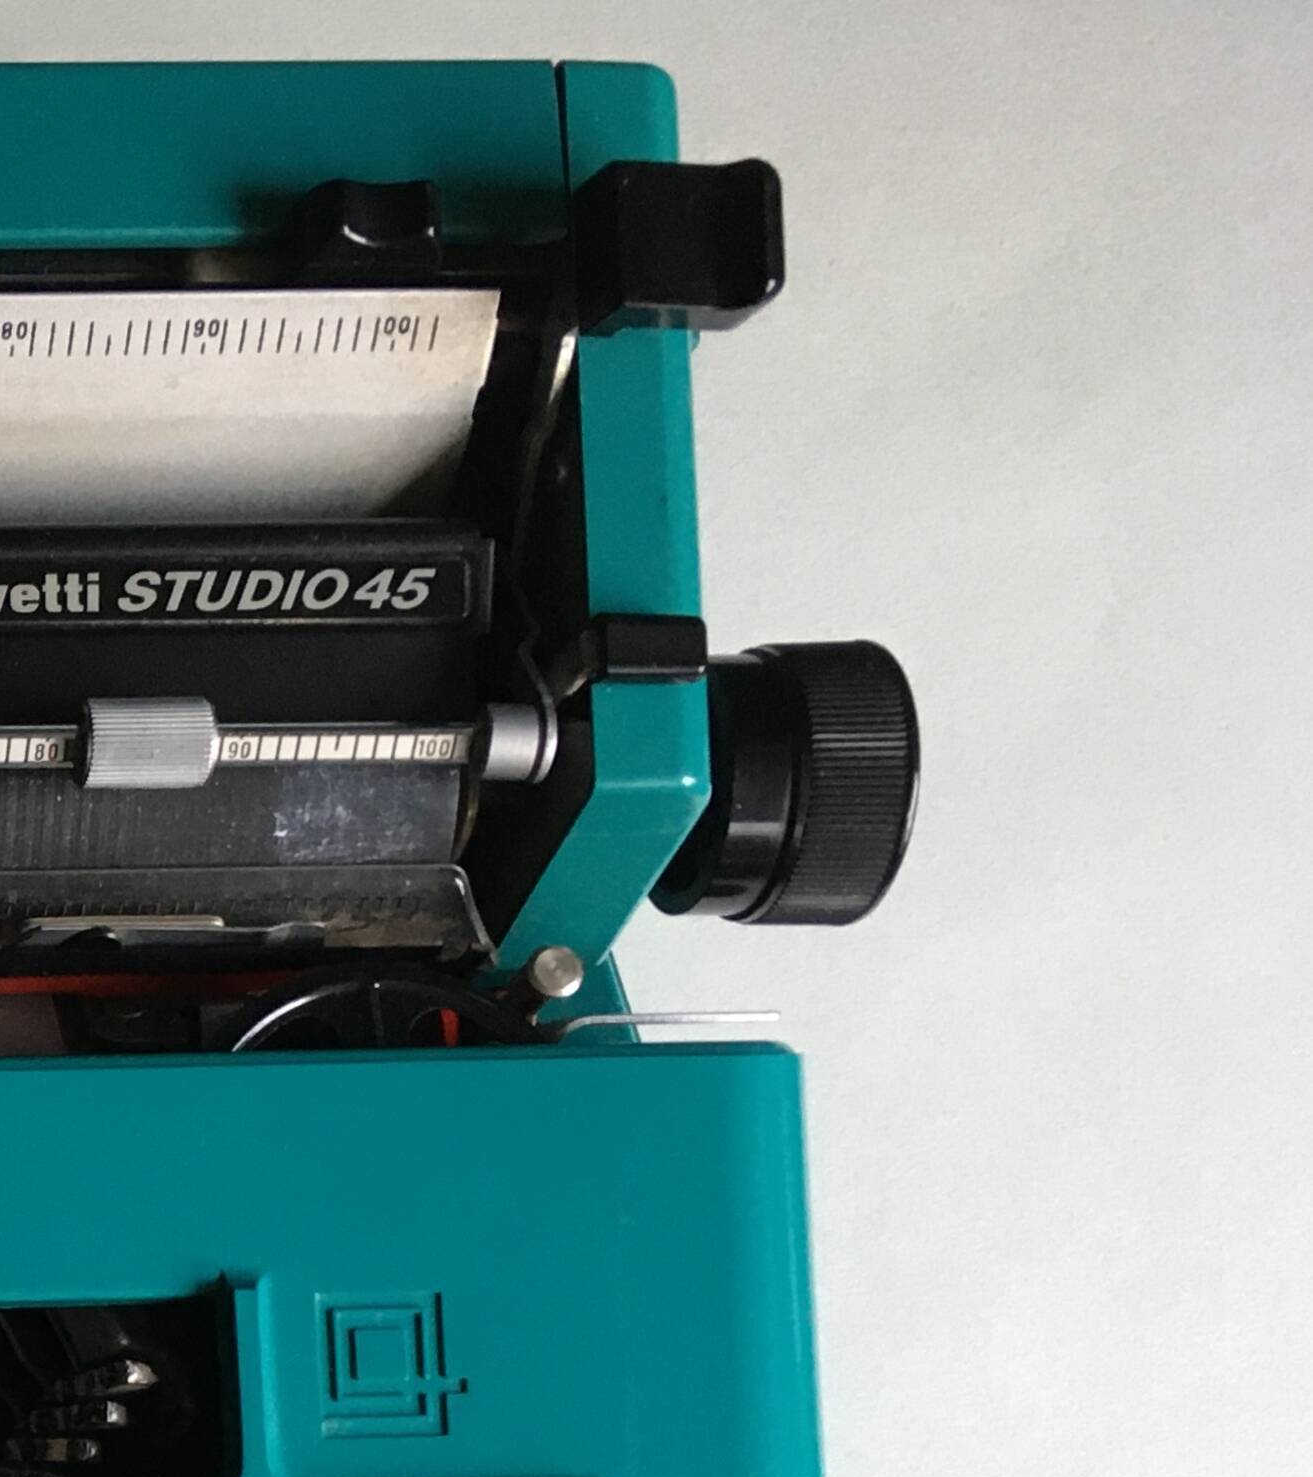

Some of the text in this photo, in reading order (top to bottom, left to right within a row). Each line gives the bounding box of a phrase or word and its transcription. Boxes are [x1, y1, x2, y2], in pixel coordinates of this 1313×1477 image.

[1, 321, 28, 340] 80
[193, 320, 220, 338] 90
[117, 568, 350, 612] STUDIO
[353, 568, 436, 610] 45
[34, 744, 59, 761] 80
[227, 742, 251, 759] 90
[418, 739, 451, 757] 100
